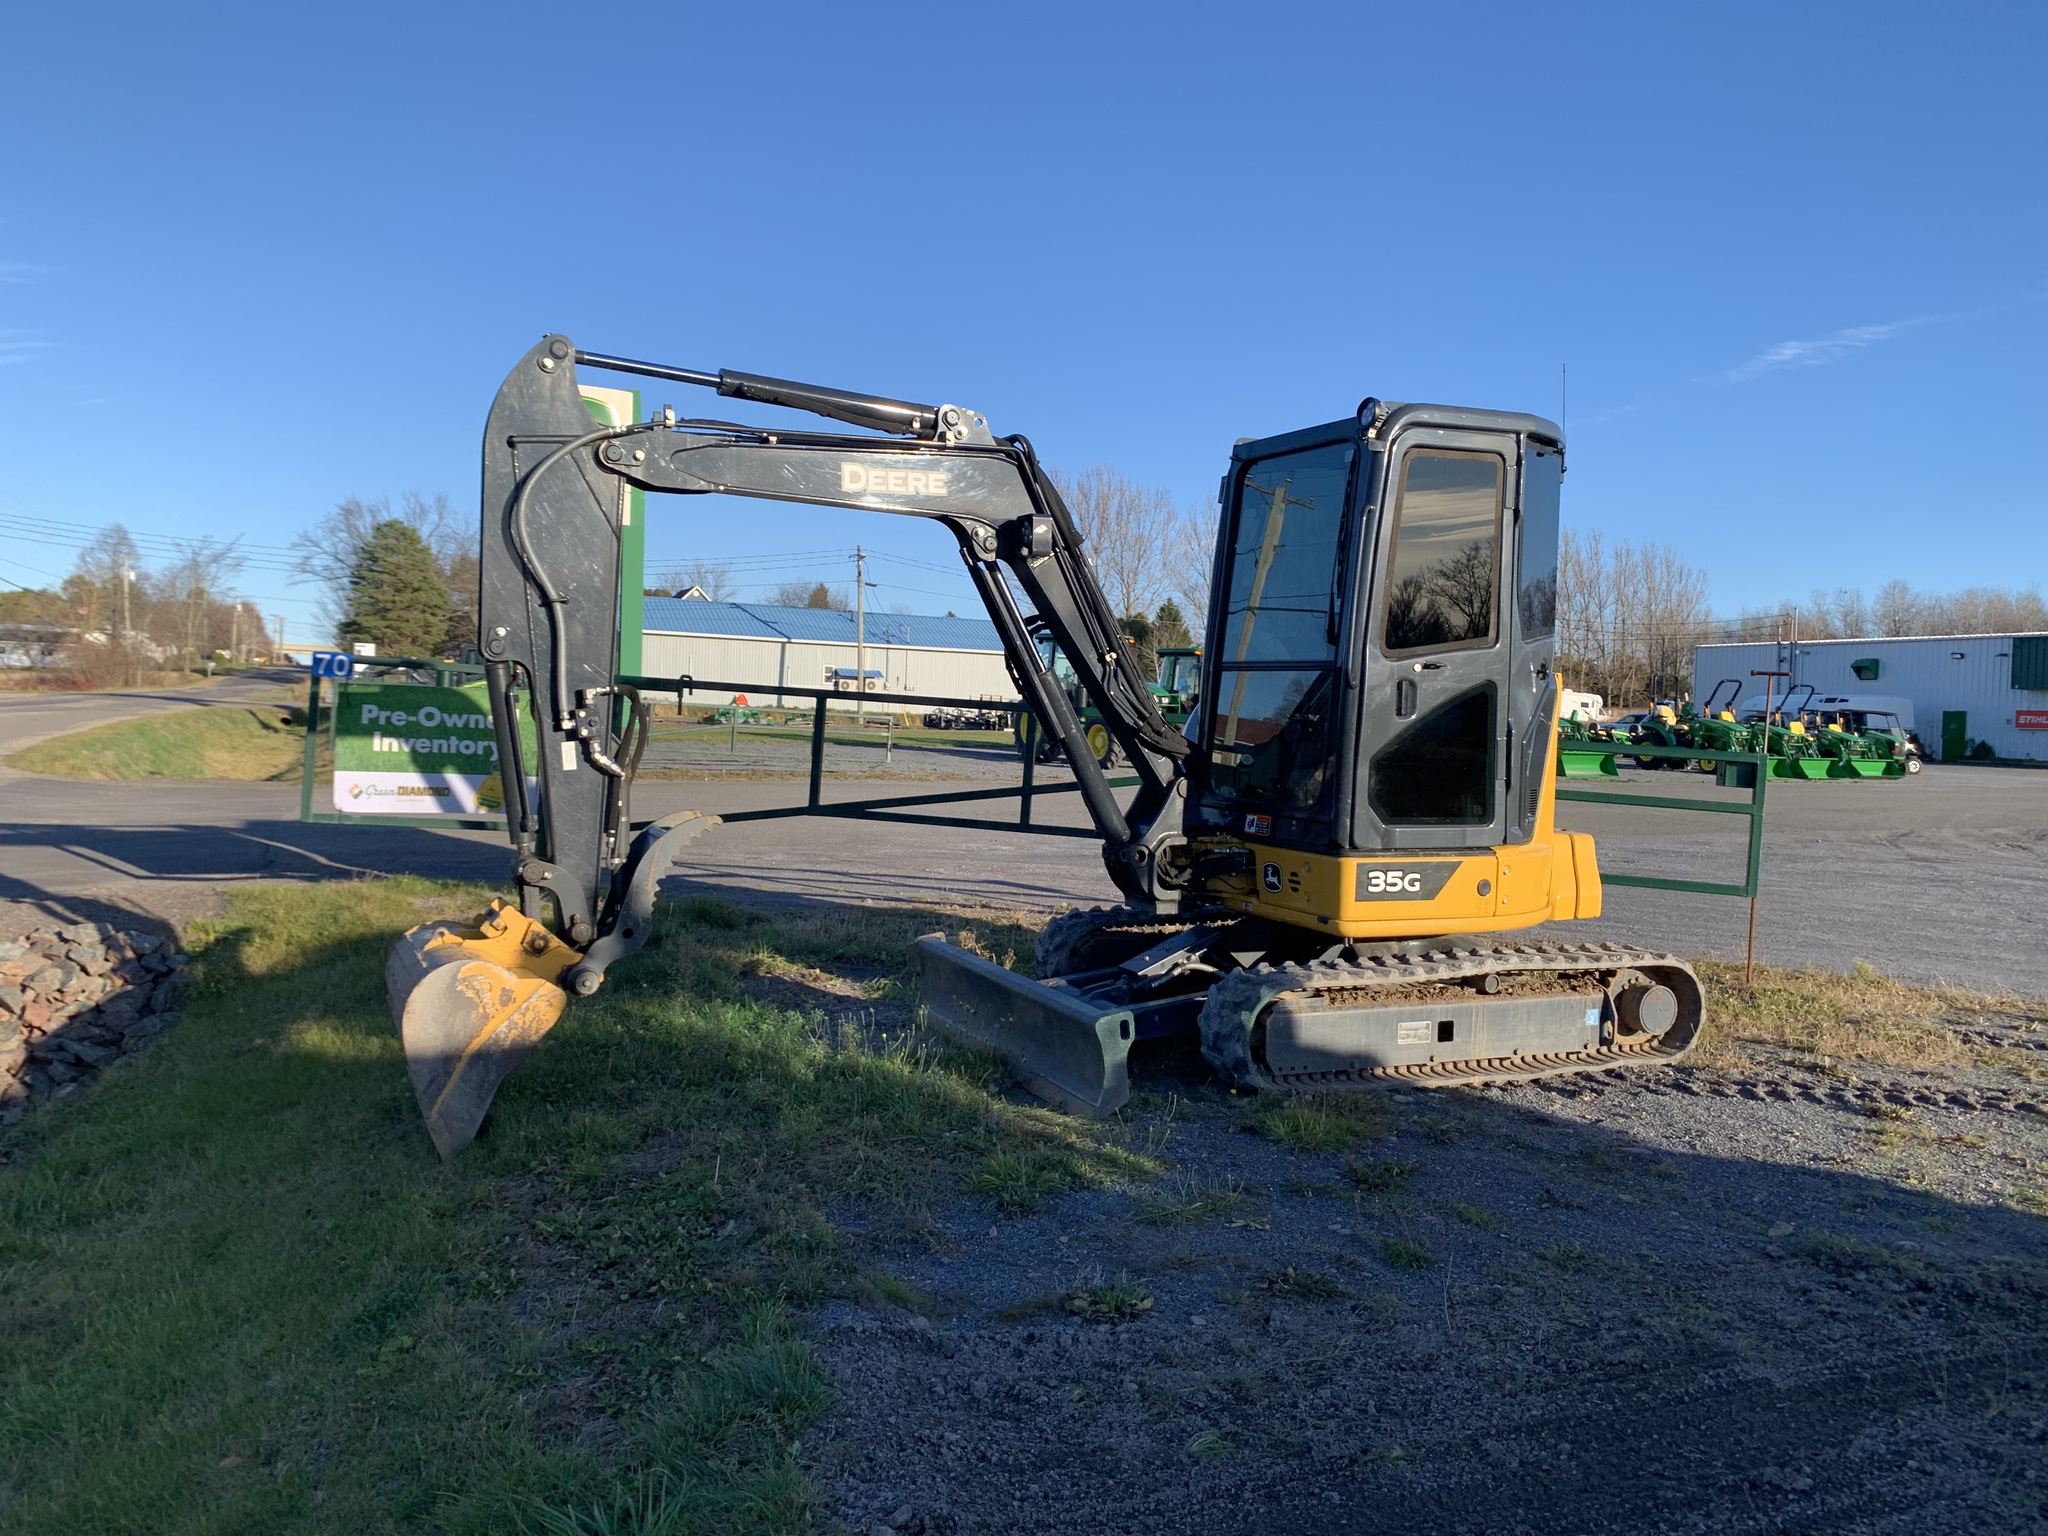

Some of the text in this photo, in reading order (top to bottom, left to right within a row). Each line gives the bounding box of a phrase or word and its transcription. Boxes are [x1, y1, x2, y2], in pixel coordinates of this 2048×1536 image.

[841, 462, 948, 496] DEERE
[315, 653, 350, 676] 70
[361, 704, 520, 729] Pre-Own
[2018, 715, 2048, 724] STIHL
[373, 731, 499, 761] Inventory
[365, 784, 450, 800] Green DIAMOND
[1367, 870, 1421, 893] 35G
